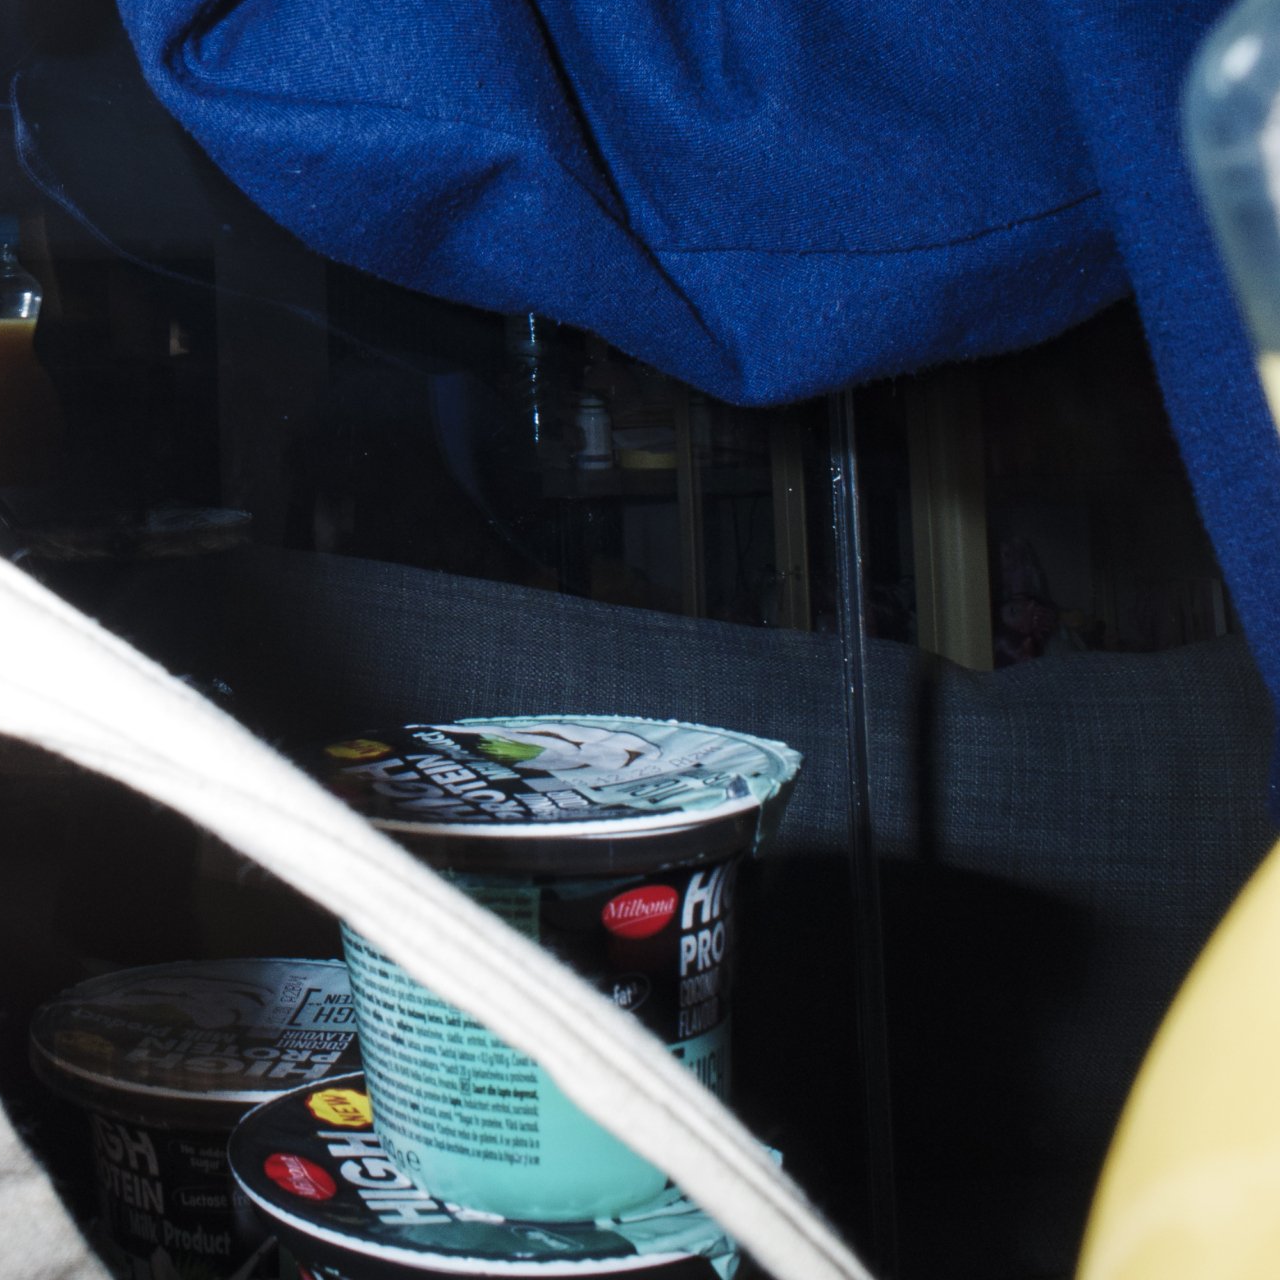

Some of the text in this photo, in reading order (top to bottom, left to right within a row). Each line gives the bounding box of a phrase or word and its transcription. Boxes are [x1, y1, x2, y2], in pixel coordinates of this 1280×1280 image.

[606, 896, 676, 920] Milbona
[135, 1036, 342, 1064] PROTEIN
[276, 1039, 350, 1051] COCONUT
[283, 1030, 355, 1042] FLAVOUR
[125, 1048, 331, 1080] HIGH
[323, 1094, 365, 1123] NEW
[317, 1130, 453, 1225] HIGH
[180, 1191, 228, 1209] Lactose
[163, 1219, 231, 1256] Product
